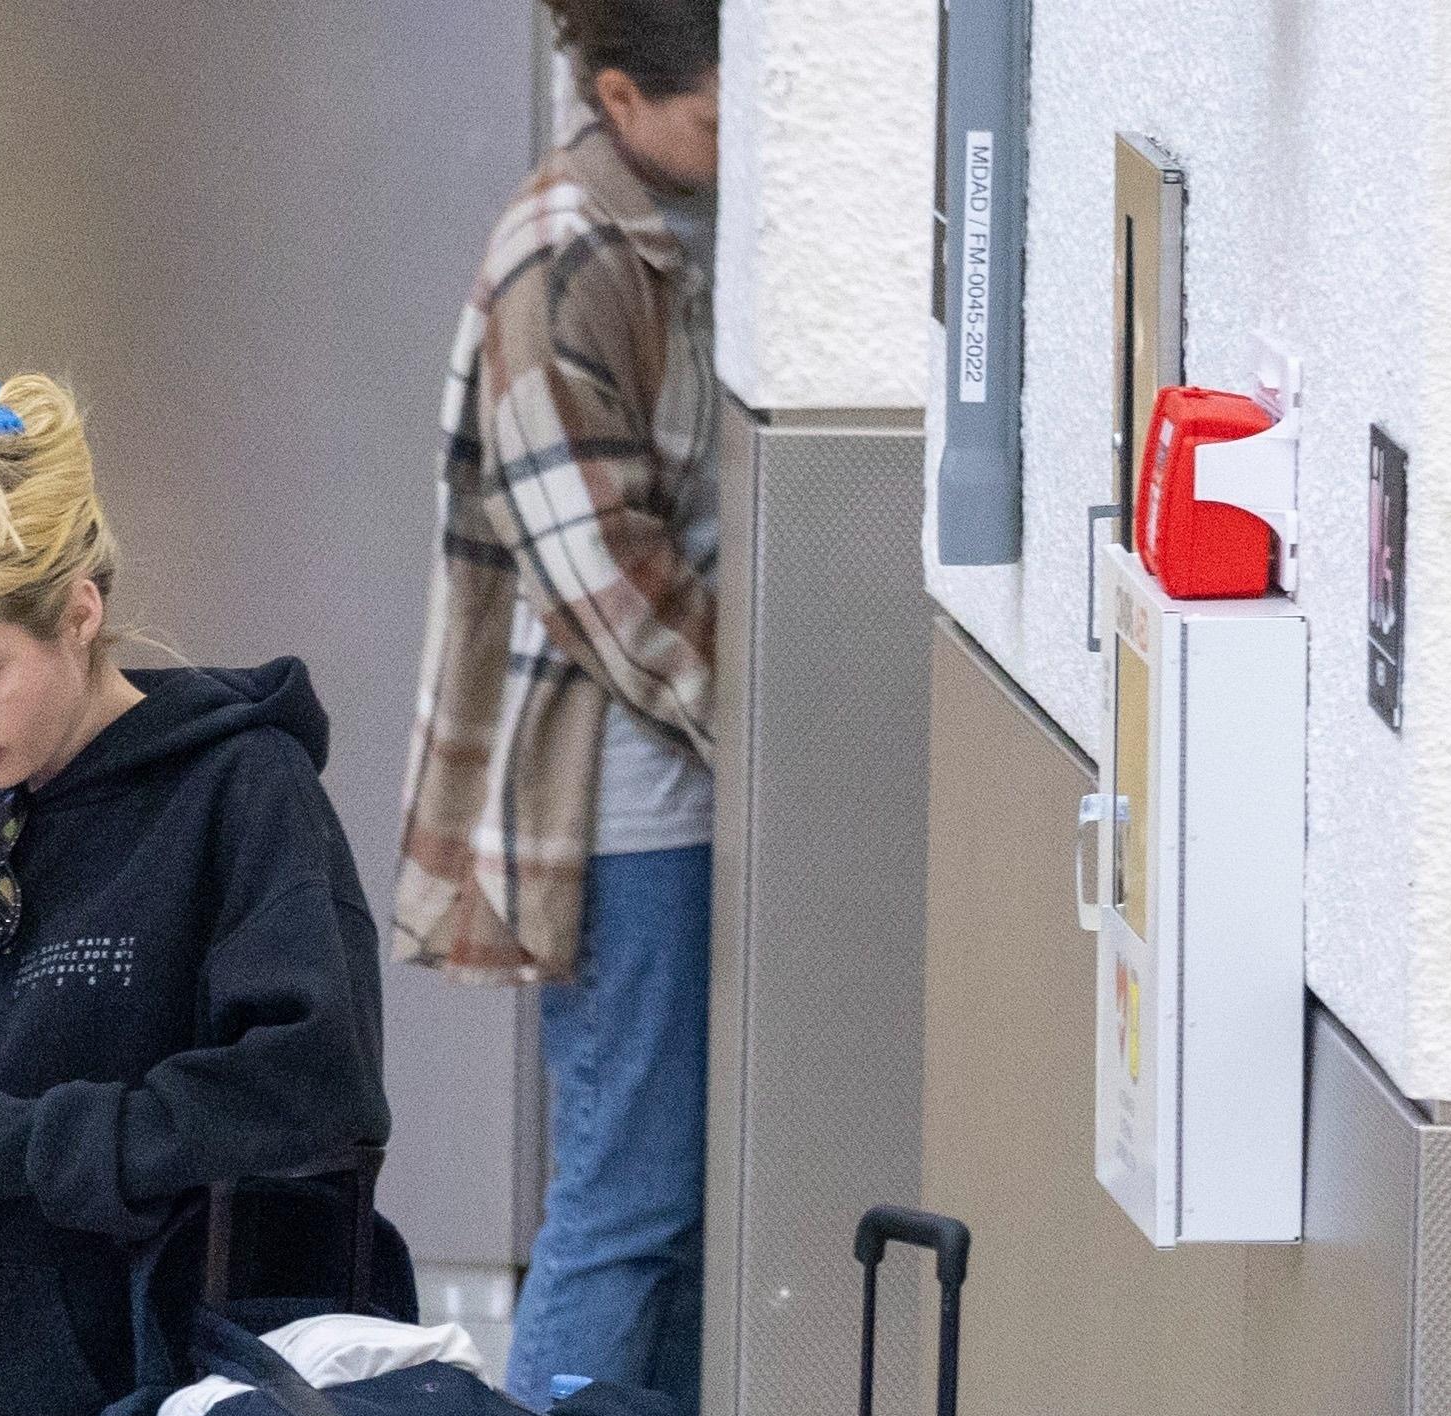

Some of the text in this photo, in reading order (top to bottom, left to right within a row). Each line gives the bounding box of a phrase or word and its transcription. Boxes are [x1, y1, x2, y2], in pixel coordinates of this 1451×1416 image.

[970, 145, 990, 213] MDAD
[965, 233, 988, 383] FM-0045-2022
[76, 937, 111, 947] MAIN
